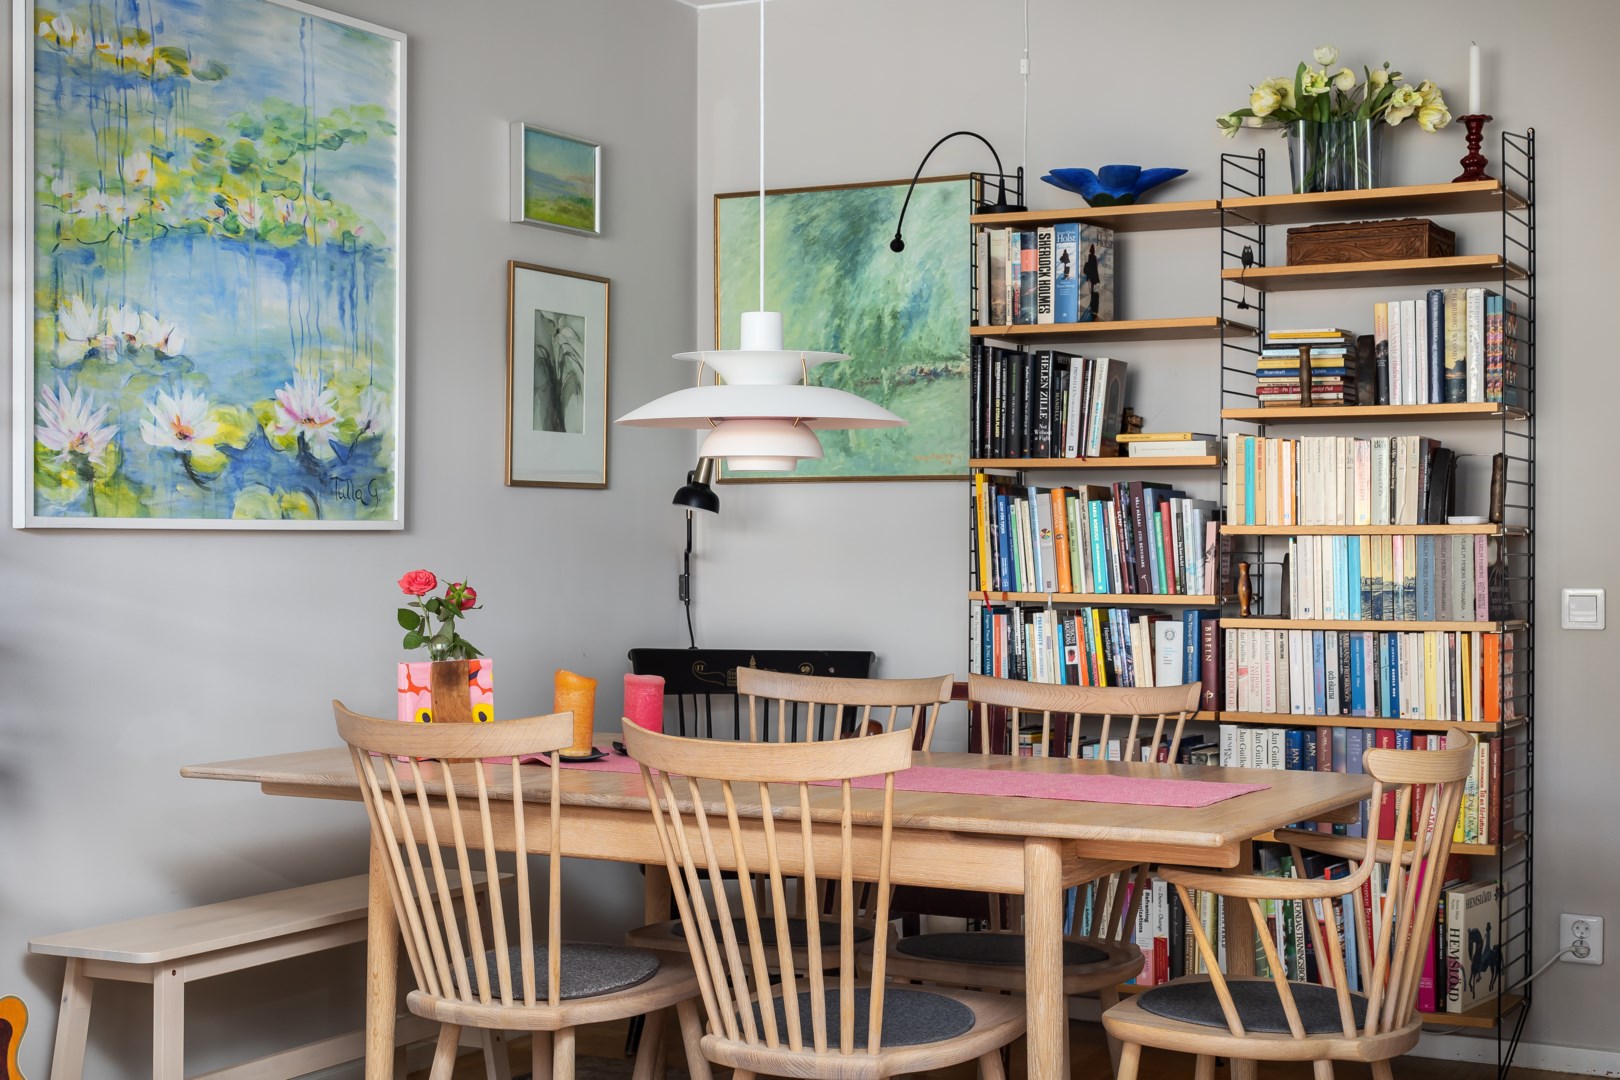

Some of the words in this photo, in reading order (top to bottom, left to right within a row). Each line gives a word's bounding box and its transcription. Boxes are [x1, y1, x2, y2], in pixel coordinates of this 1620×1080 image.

[1038, 233, 1051, 278] SHERLOCK
[1038, 280, 1051, 315] HOLMES
[1039, 355, 1049, 389] HELEN
[1039, 391, 1049, 420] ZILLE
[1328, 671, 1336, 681] och
[1255, 731, 1263, 744] Jan
[1271, 731, 1279, 745] Jan
[1479, 798, 1484, 806] en
[1466, 891, 1491, 910] HEMSLÖJD
[1448, 927, 1461, 1002] HEMSLÖJD
